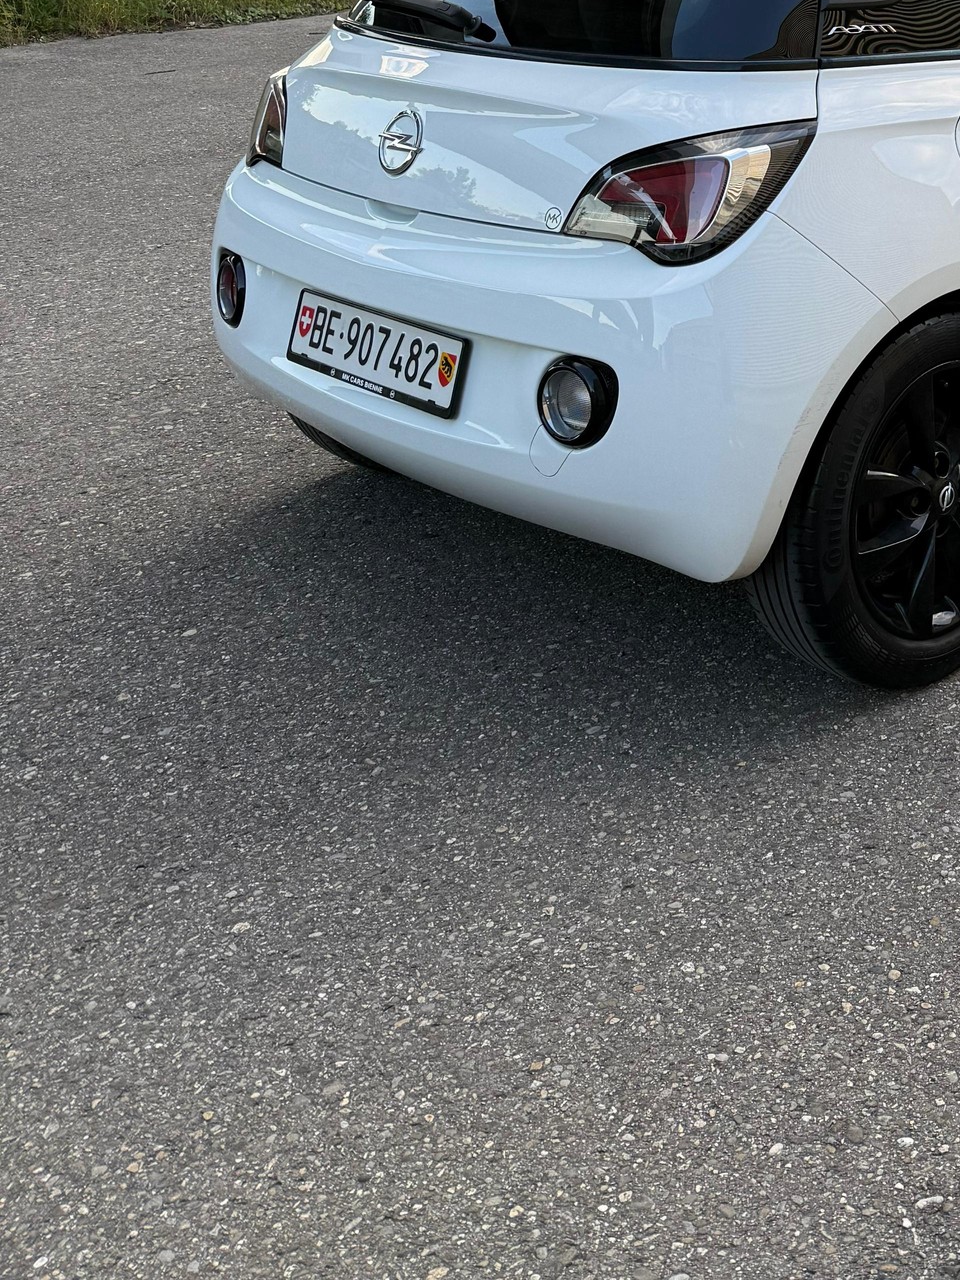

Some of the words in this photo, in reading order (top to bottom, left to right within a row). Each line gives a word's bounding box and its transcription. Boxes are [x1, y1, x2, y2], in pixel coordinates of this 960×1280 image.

[341, 372, 350, 382] MK
[350, 376, 364, 387] CARS
[364, 381, 384, 394] BIENNE
